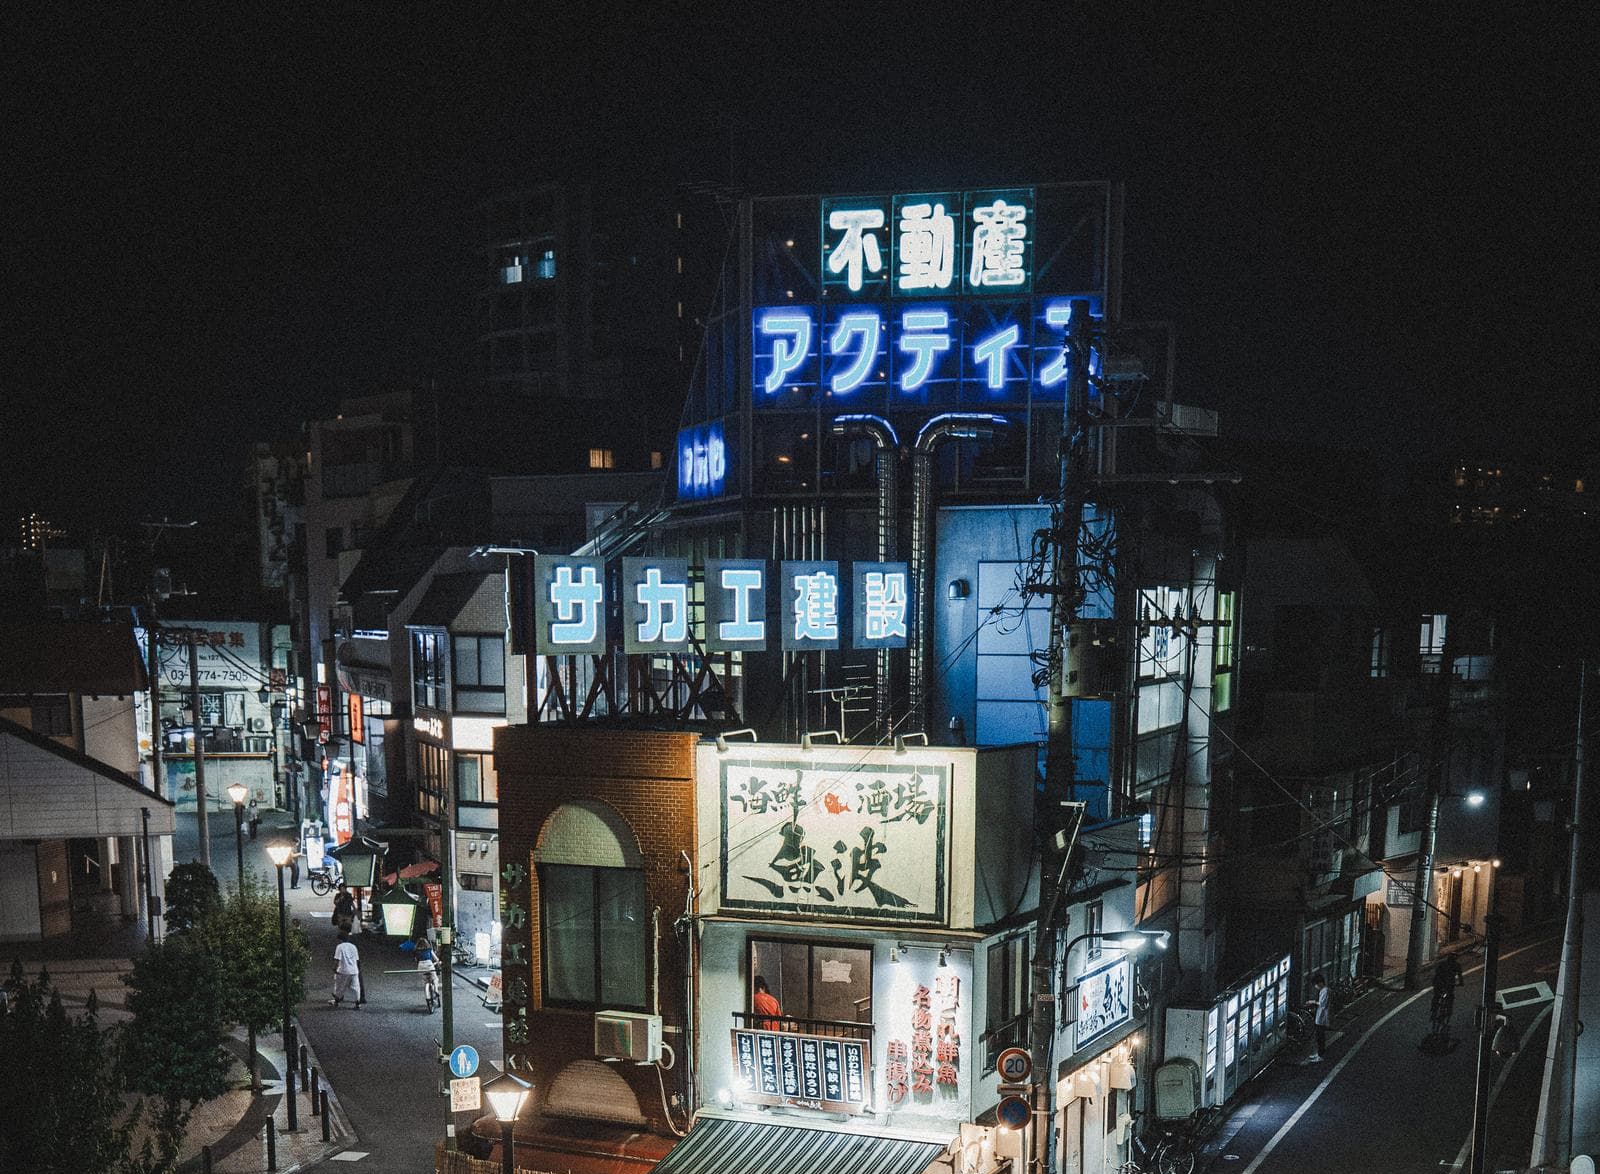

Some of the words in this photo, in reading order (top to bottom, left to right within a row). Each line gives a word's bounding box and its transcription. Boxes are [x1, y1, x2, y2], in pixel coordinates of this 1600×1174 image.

[828, 200, 1026, 291] 不動産
[551, 567, 907, 644] サカエ建設
[170, 669, 249, 682] 03-774-7505
[730, 769, 807, 825] 海鮮
[856, 771, 936, 825] 酒場
[741, 821, 919, 908] 魚波
[886, 1038, 908, 1104] 串揚げ
[1005, 1058, 1025, 1074] 20
